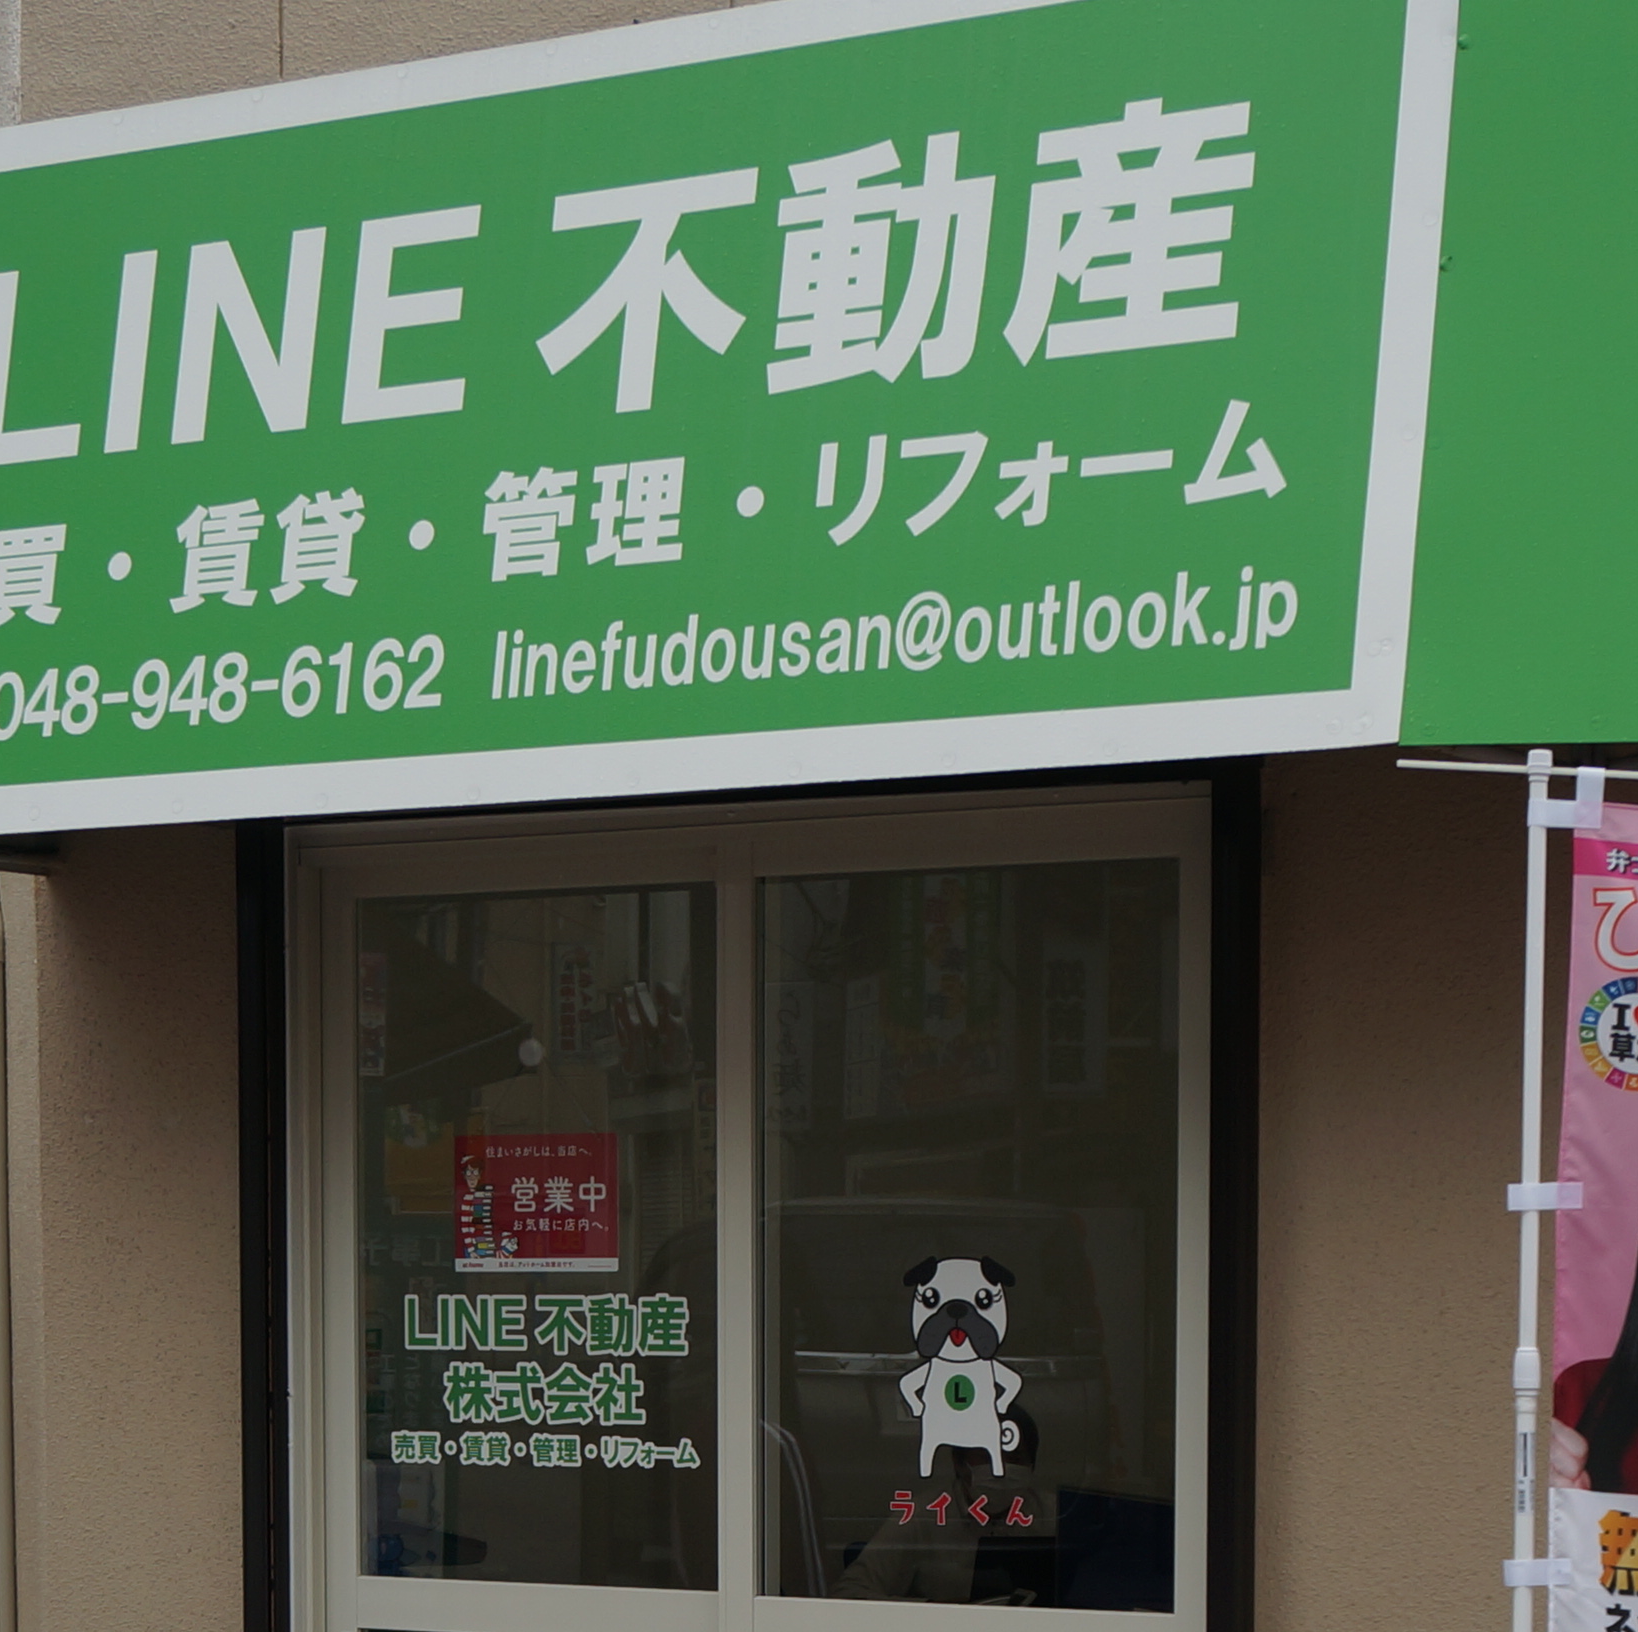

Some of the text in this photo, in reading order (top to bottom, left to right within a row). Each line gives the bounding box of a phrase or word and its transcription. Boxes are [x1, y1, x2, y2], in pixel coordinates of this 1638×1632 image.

[535, 97, 1256, 414] 不動産
[491, 566, 1299, 701] linefudousan@outlook.jp
[485, 1145, 592, 1159] 住まいさがしは、当店へ。
[511, 1175, 607, 1214] 営業中
[513, 1217, 610, 1233] お気軽に店内へ。
[404, 1292, 691, 1356] LINE 不動産
[443, 1361, 647, 1426] 株式会社
[953, 1381, 967, 1403] L
[391, 1430, 701, 1469] 売買・賃貸・管理・リフォーム
[889, 1490, 1034, 1527] ライくん
